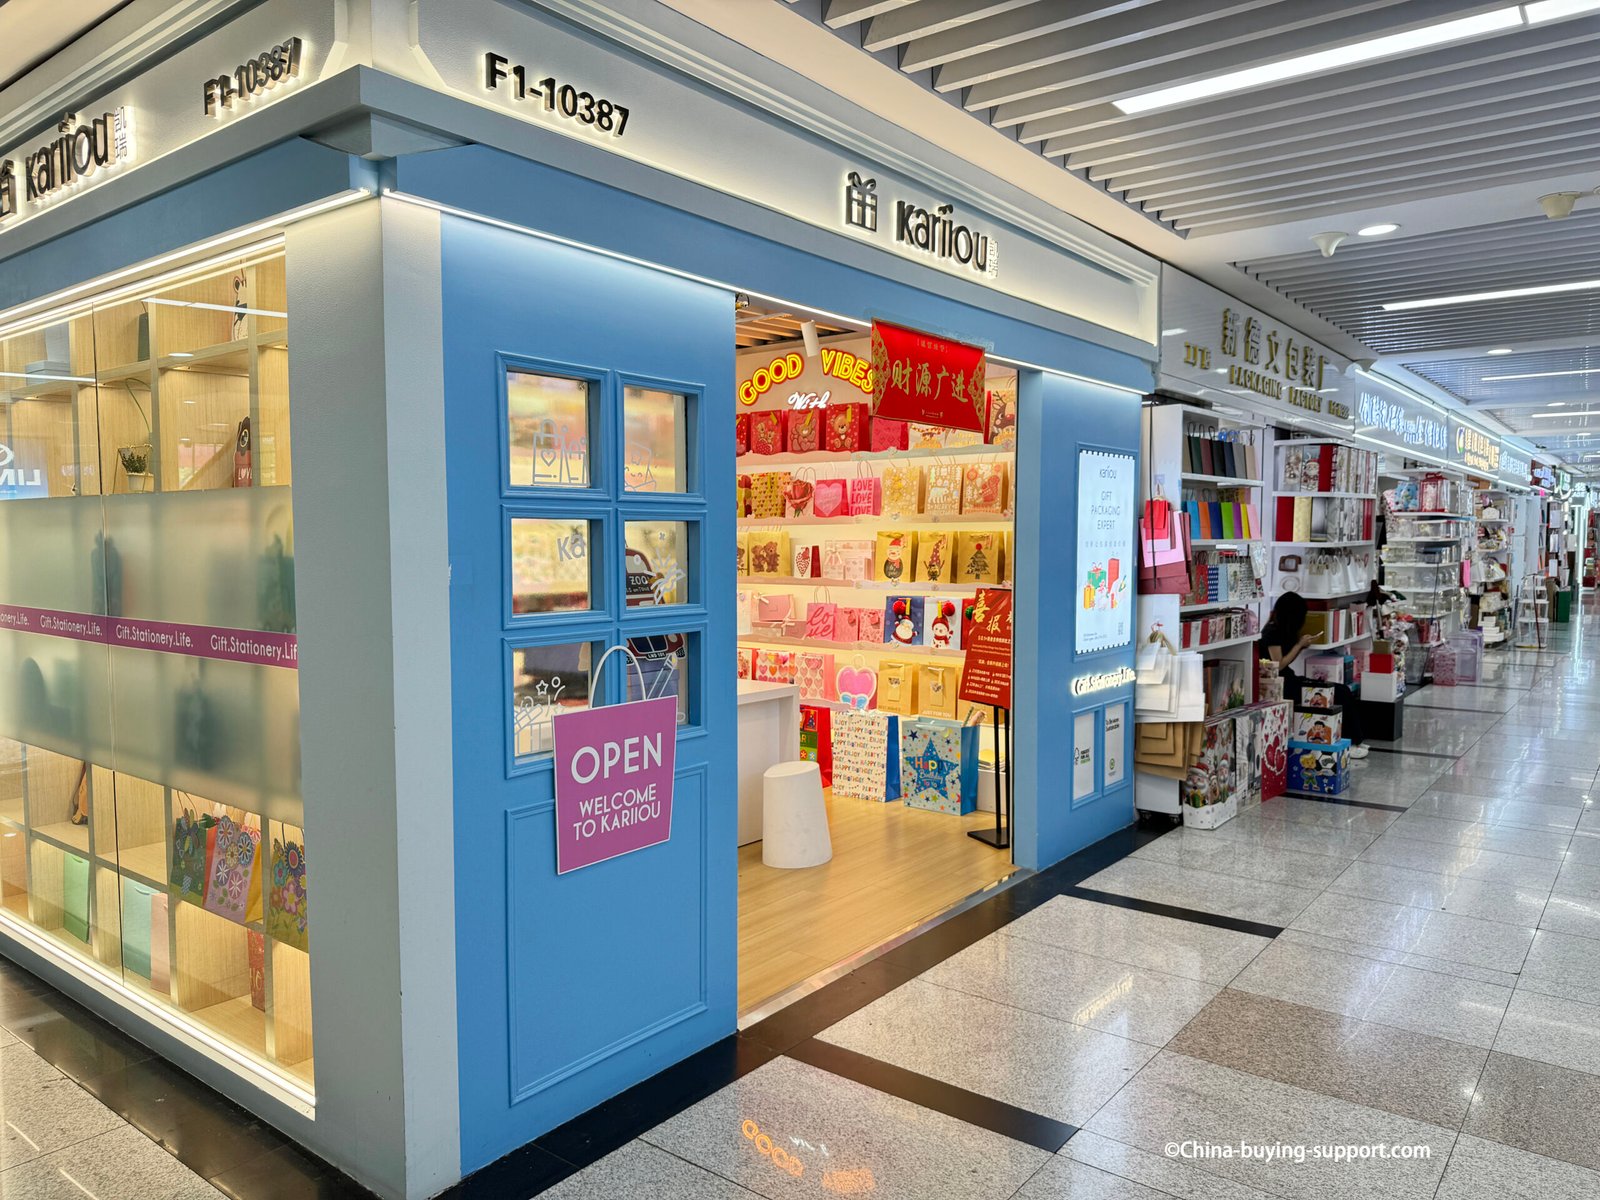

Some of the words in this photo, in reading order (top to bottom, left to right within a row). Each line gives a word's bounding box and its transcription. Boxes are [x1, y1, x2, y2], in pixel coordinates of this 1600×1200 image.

[203, 37, 302, 117] F1-10387
[485, 52, 630, 138] F1-10387
[739, 353, 804, 406] GOOD
[820, 348, 874, 395] VIBES
[890, 358, 969, 403] 财源广进
[1229, 364, 1282, 400] PACKAGING
[851, 493, 872, 504] LOVE
[852, 480, 873, 491] LOVE
[850, 505, 872, 515] LOVE
[40, 614, 103, 637] Gift.Stationery.Life.
[116, 624, 194, 648] Gift.Stationery.Life.
[571, 732, 662, 784] OPEN
[580, 783, 657, 818] WELCOME
[573, 819, 596, 841] TO
[601, 800, 661, 833] KARIIOU
